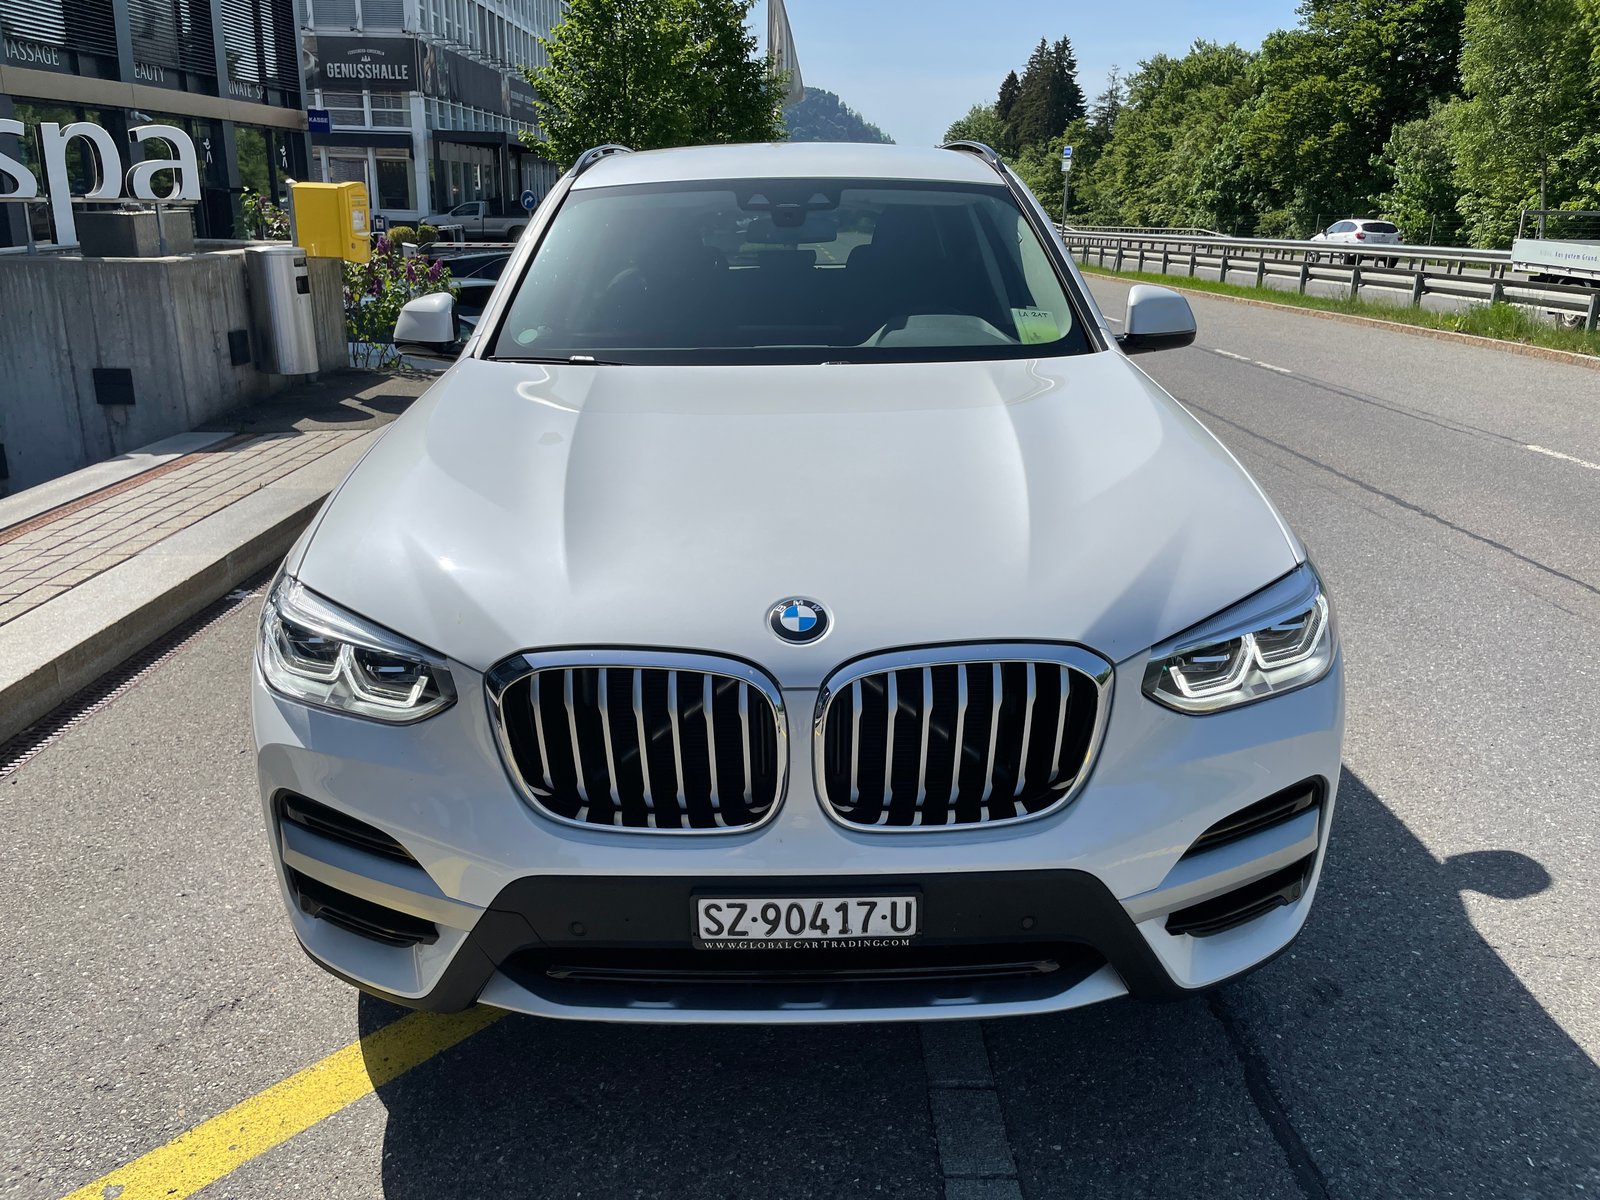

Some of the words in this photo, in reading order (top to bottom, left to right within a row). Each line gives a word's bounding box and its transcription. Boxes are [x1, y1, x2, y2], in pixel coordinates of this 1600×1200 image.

[326, 62, 409, 80] GENUSSHALLE
[308, 116, 329, 124] KASSE
[0, 118, 201, 246] spa
[775, 600, 823, 613] BMW
